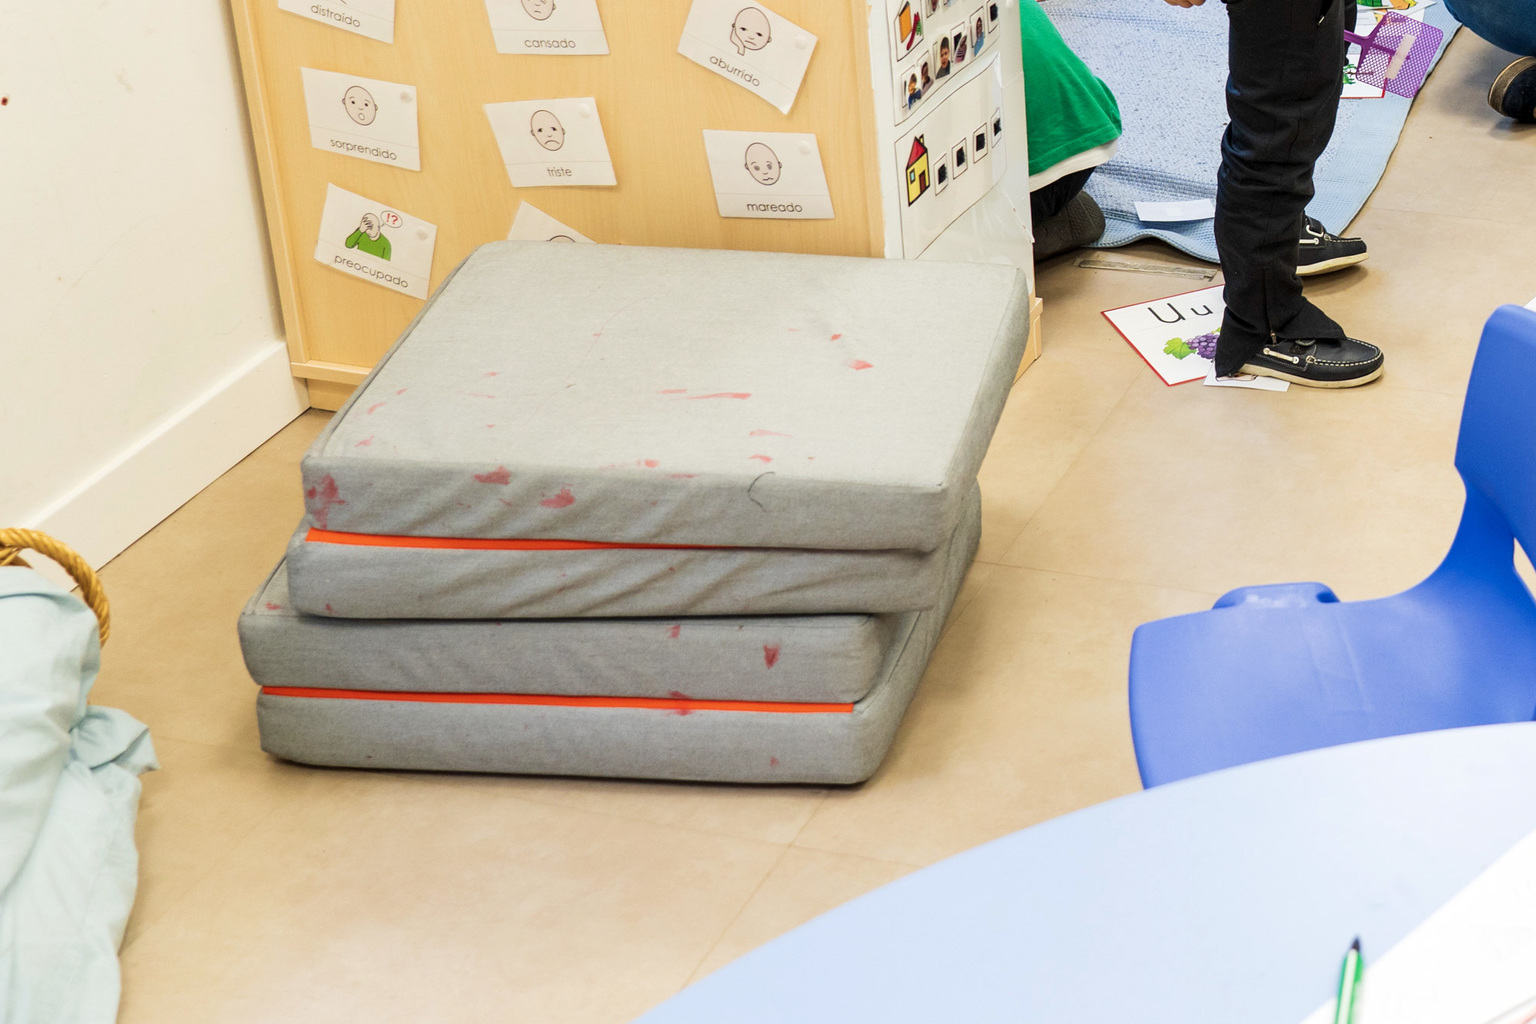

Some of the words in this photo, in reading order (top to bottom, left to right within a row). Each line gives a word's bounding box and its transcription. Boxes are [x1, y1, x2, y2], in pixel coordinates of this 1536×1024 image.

[524, 35, 576, 49] cansado
[709, 52, 760, 88] aburrido
[329, 136, 397, 162] sorprendido
[546, 164, 572, 178] triste
[746, 200, 803, 213] mareado
[334, 255, 409, 288] preocupado
[1147, 303, 1186, 323] U
[1190, 305, 1213, 316] u
